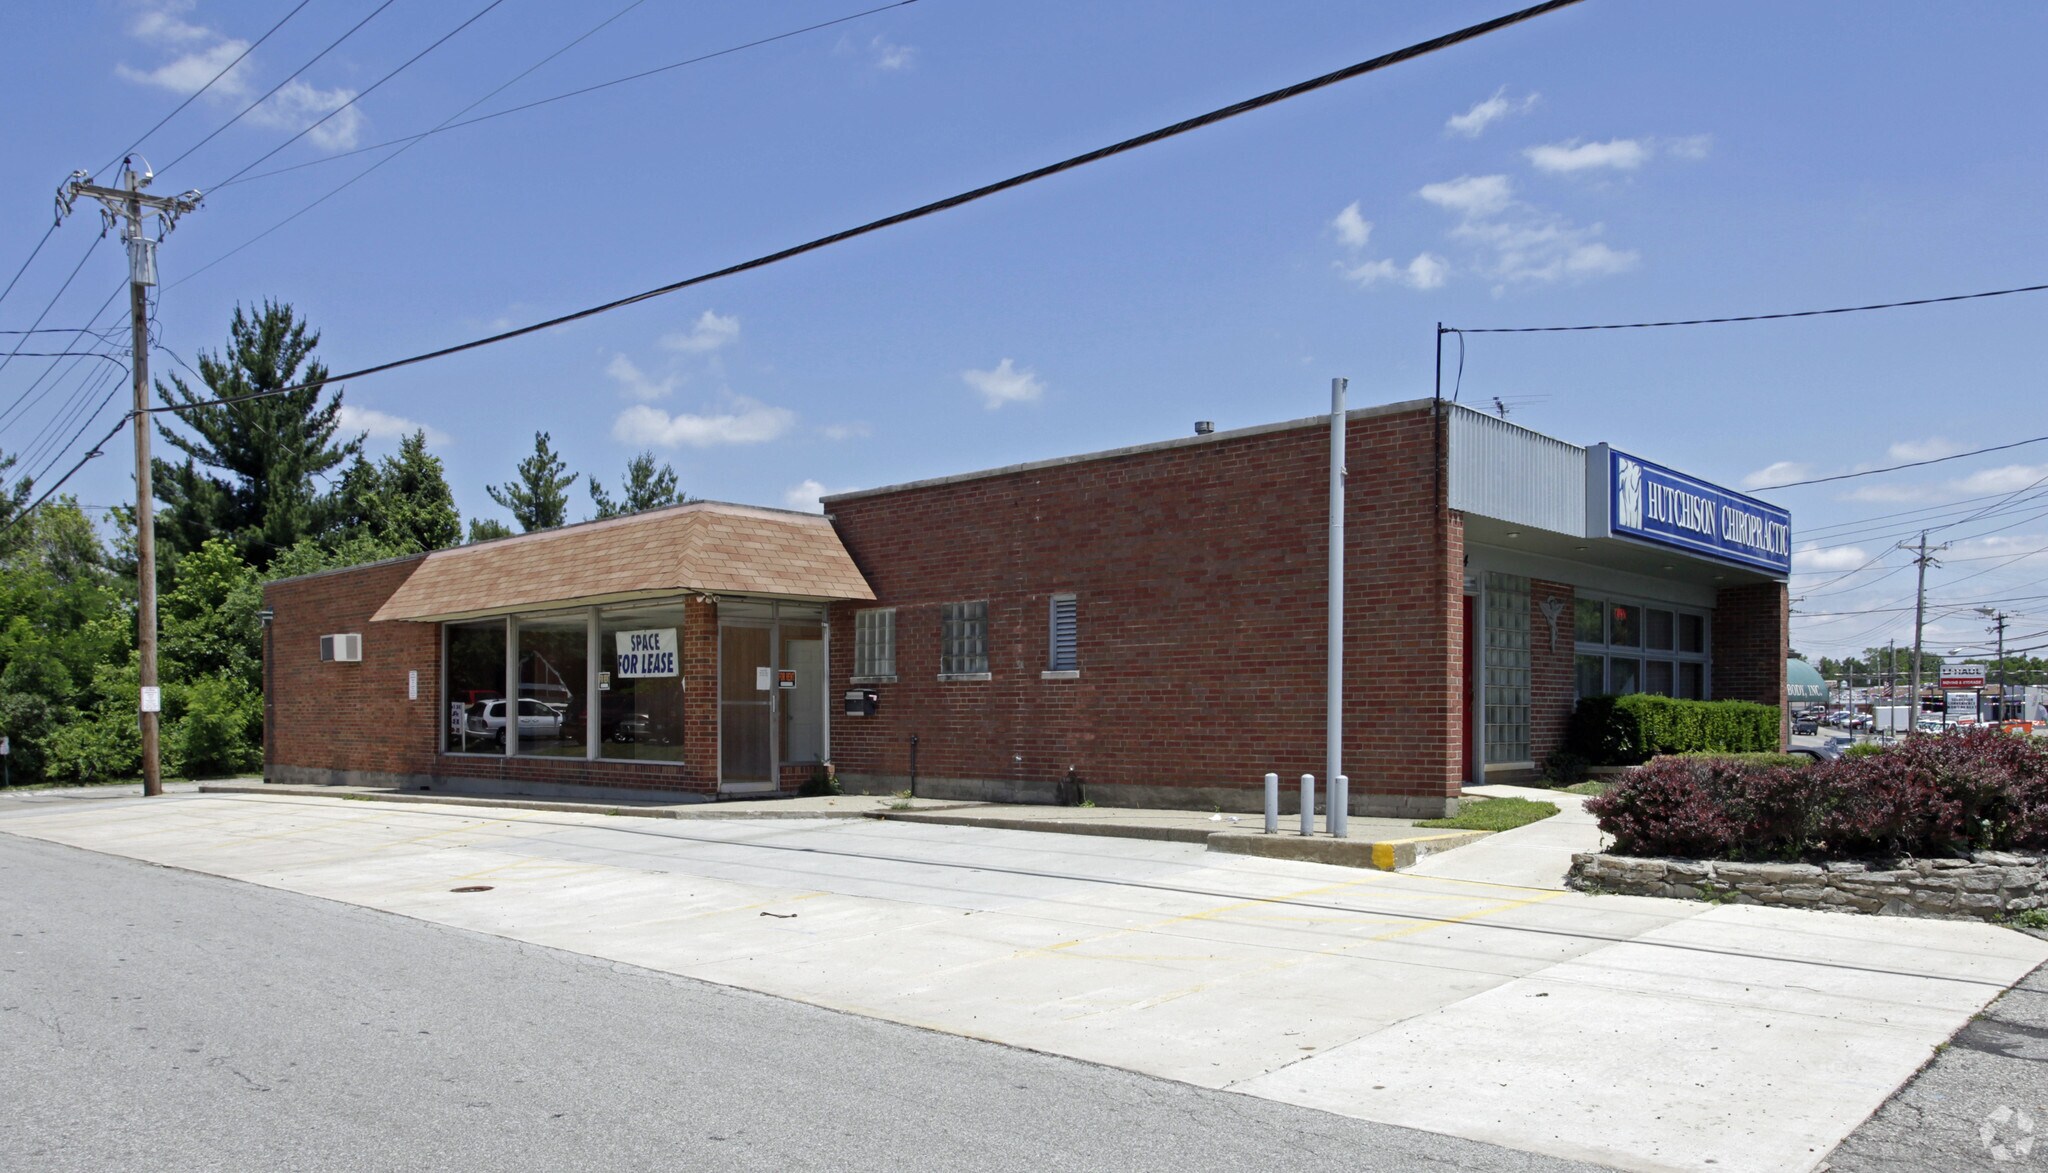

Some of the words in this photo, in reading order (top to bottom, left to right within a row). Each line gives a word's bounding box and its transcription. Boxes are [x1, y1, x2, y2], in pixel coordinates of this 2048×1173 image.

[1647, 481, 1716, 537] HUTCHISON
[1721, 505, 1789, 557] CHIROPRACTIC
[631, 633, 660, 651] SPACE
[618, 654, 638, 674] FOR
[641, 652, 673, 674] LEASE
[1787, 684, 1807, 698] BODY,
[1807, 684, 1823, 697] INC.
